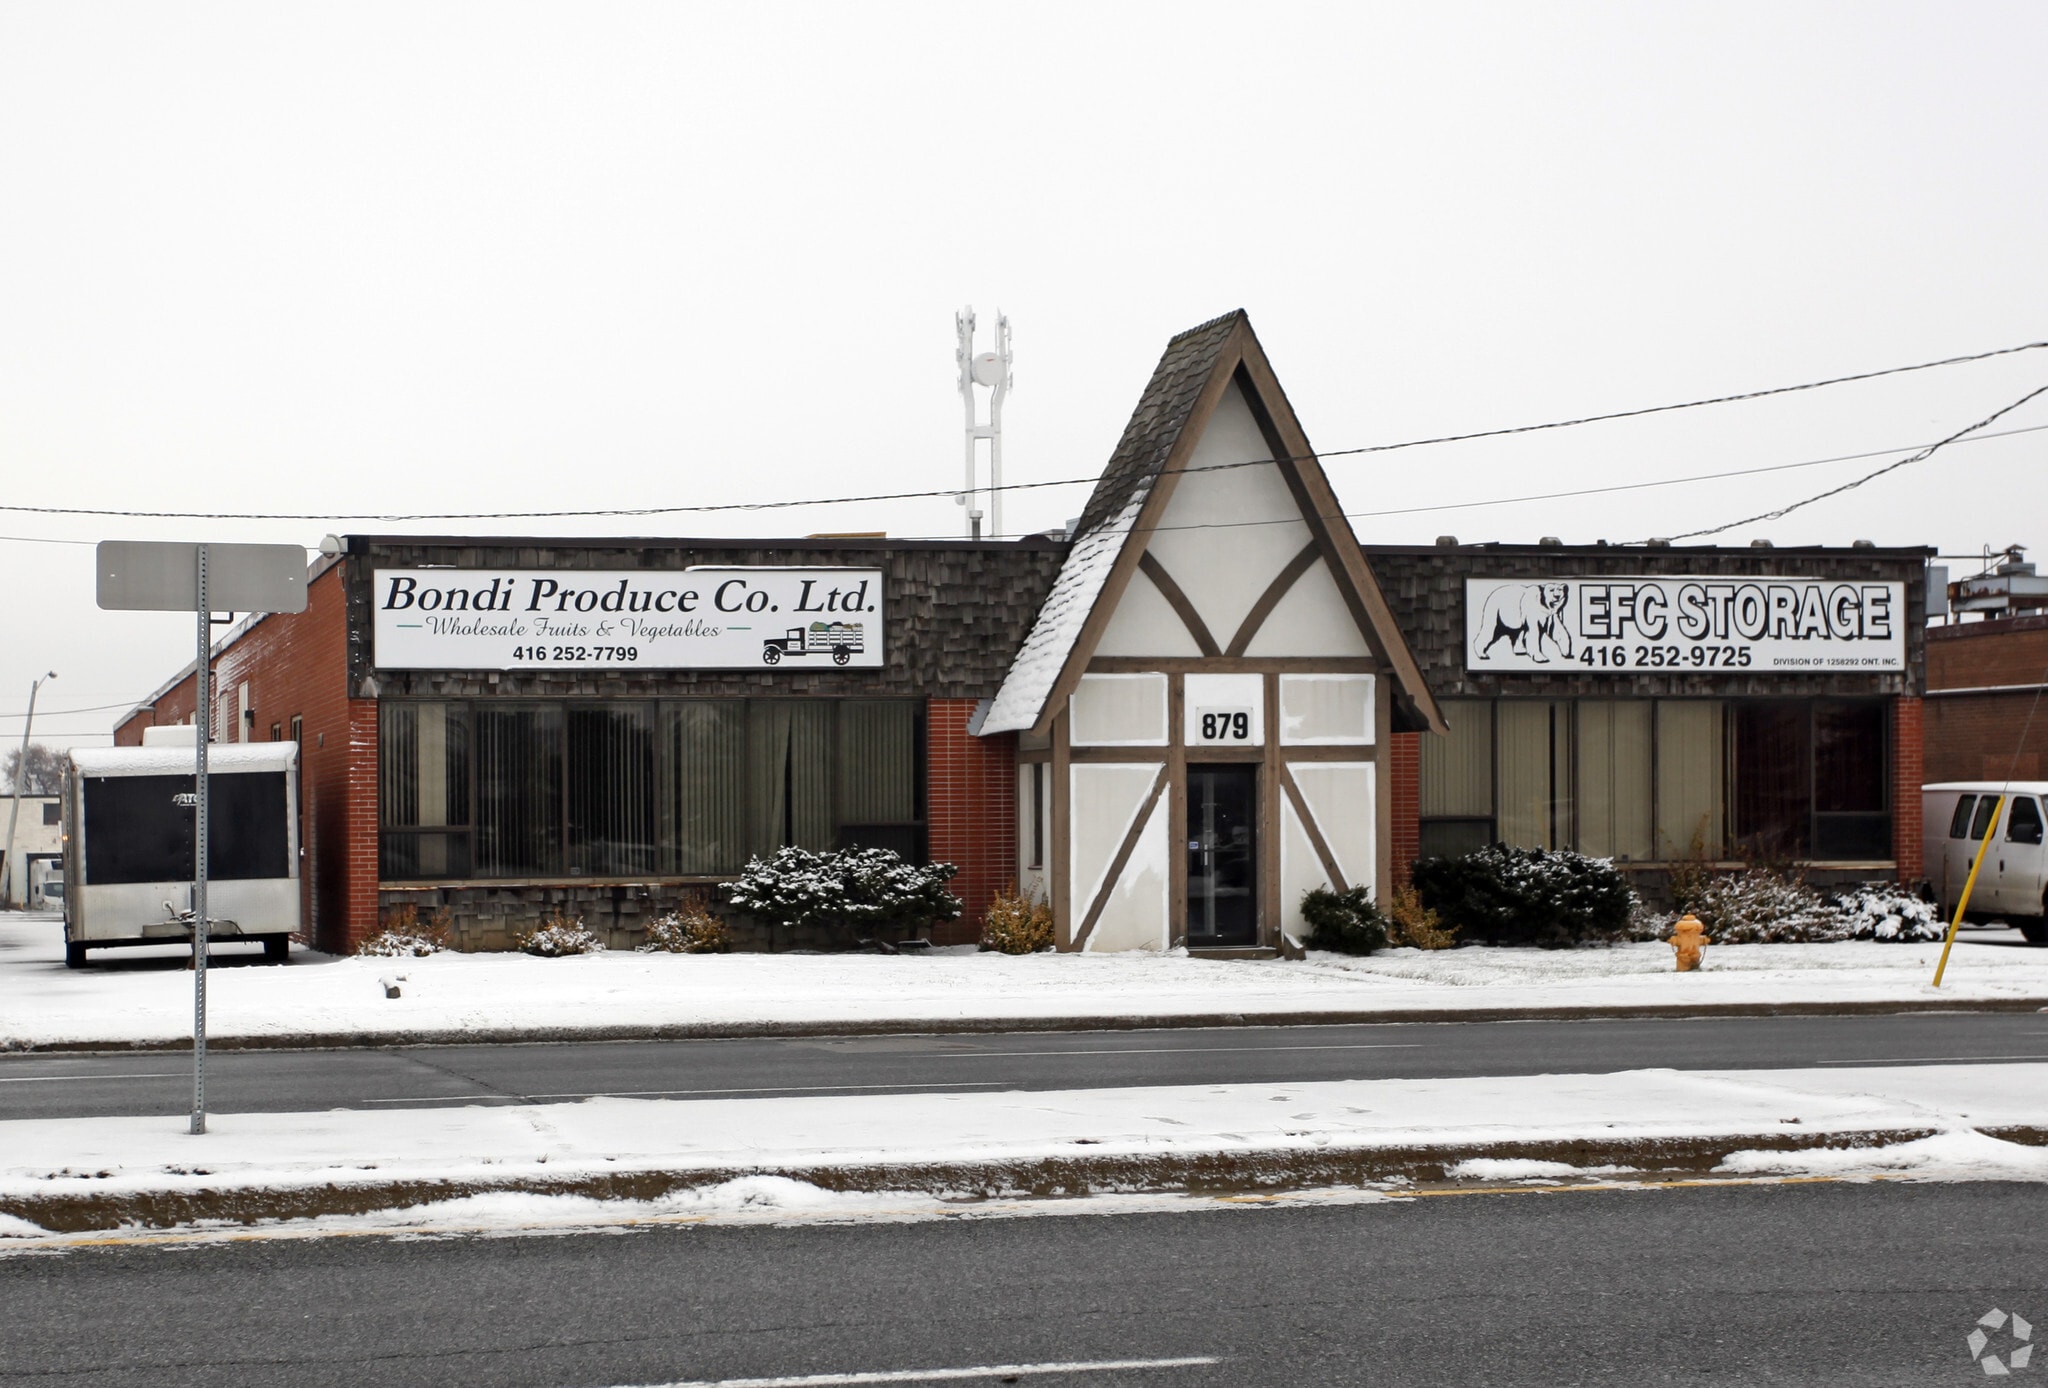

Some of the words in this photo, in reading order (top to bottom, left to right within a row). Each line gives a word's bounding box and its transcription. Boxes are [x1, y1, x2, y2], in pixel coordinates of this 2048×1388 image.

[382, 578, 514, 611] Bondi
[525, 578, 699, 612] Produce
[715, 580, 778, 612] Co.
[793, 580, 875, 612] Ltd.
[1579, 583, 1668, 640] EFC
[1677, 583, 1892, 640] STORAGE
[426, 616, 526, 637] Wholesale
[534, 617, 589, 637] Fruits
[596, 620, 614, 637] &
[620, 617, 721, 641] Vegetables
[513, 646, 546, 661] 416
[553, 646, 638, 661] 252-7799
[1580, 645, 1627, 667] 416
[1635, 645, 1752, 667] 252-9725
[1773, 658, 1811, 666] DIVISION
[1812, 658, 1824, 666] OF
[1882, 658, 1899, 666] INC.
[1202, 712, 1249, 740] 879
